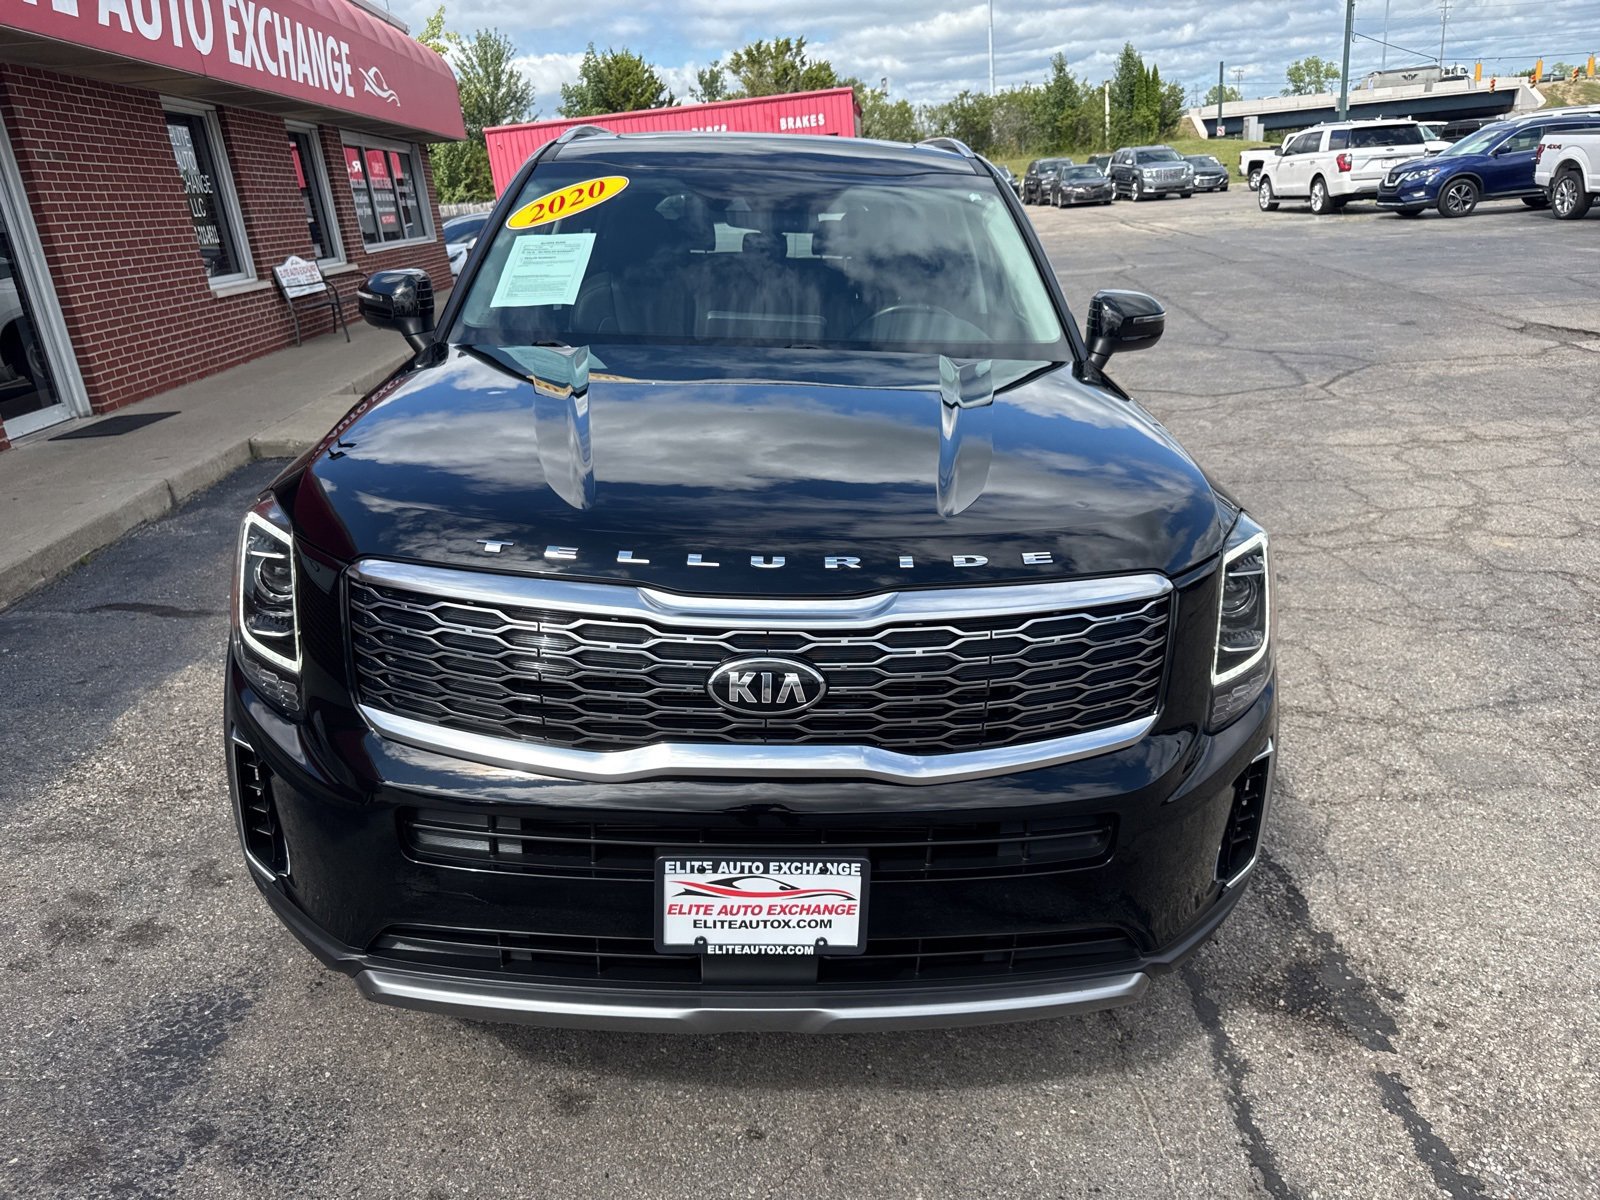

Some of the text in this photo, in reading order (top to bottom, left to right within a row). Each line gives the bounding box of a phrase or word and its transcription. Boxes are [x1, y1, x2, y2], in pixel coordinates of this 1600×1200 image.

[223, 0, 355, 98] EXCHANGE
[780, 113, 825, 131] BRAKES
[189, 198, 207, 217] LLC
[529, 181, 605, 224] 2020
[476, 539, 1054, 569] TELLURIDE
[727, 671, 809, 705] KIA
[664, 861, 861, 876] ELITE AUTO EXCHANGE
[667, 903, 858, 916] ELITE AUTO EXCHANGE
[692, 918, 832, 930] ELITEAUTOX.COM
[707, 944, 814, 955] ELITEAUTOX.COM
